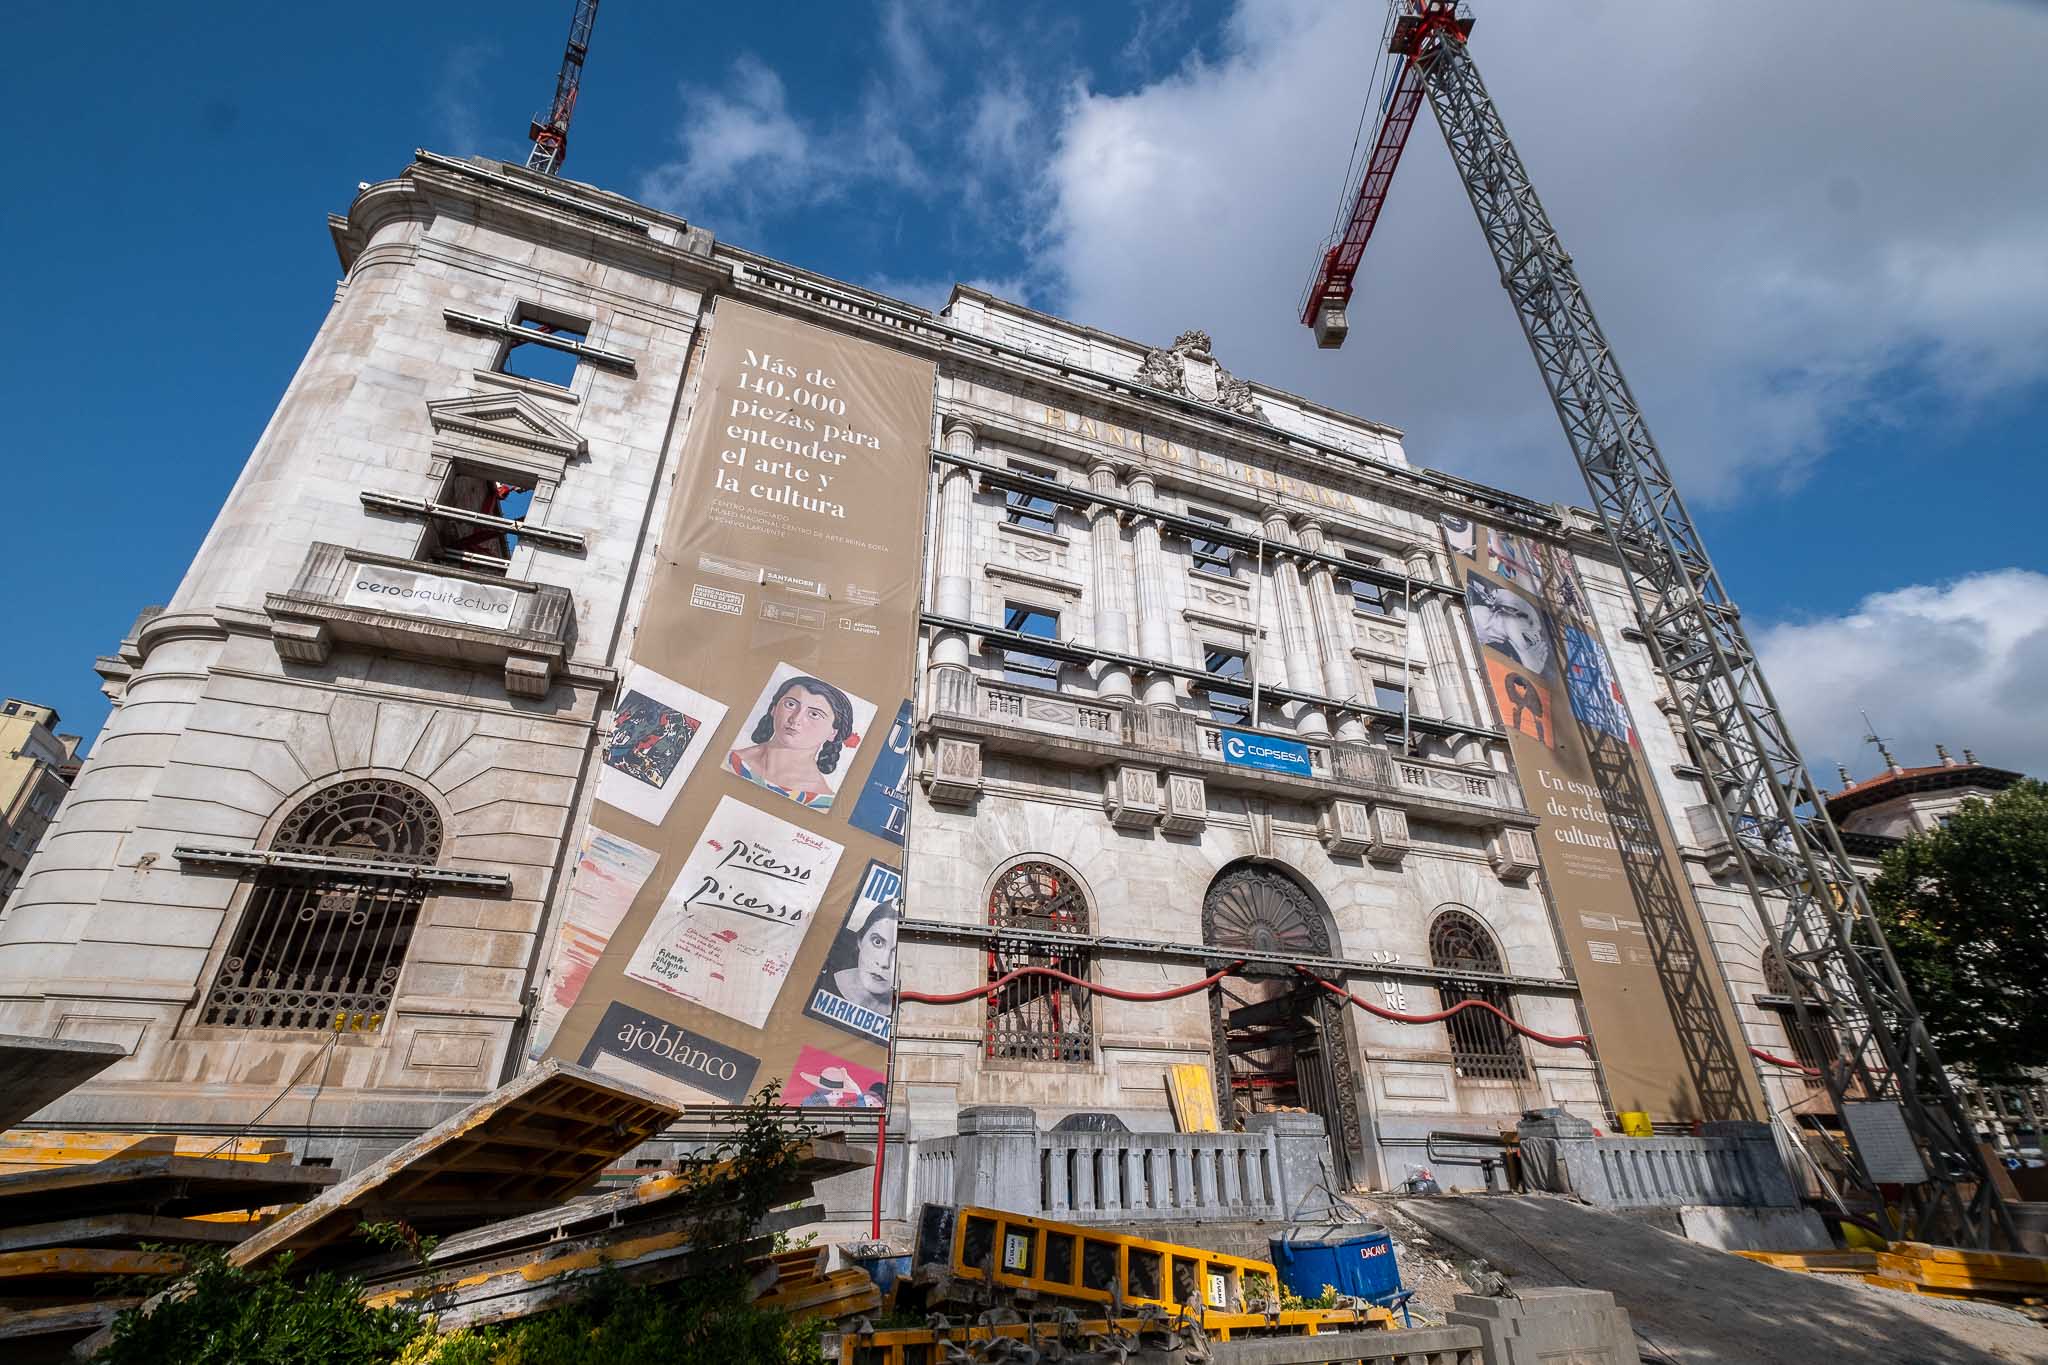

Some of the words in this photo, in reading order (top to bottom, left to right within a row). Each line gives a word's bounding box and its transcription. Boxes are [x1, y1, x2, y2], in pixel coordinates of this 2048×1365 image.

[741, 348, 797, 378] Más
[806, 369, 837, 389] de
[737, 372, 846, 416] 140.000
[731, 399, 815, 432] piezas
[823, 424, 881, 449] para
[727, 425, 847, 465] entender
[721, 447, 747, 467] el
[754, 457, 809, 482] arte
[817, 473, 834, 492] y
[715, 468, 740, 493] la
[750, 484, 846, 518] cultura
[356, 580, 509, 614] ceroarquitectura
[767, 572, 814, 587] SANTANDER
[693, 599, 717, 609] REINA
[1247, 745, 1306, 764] COPSESA
[1537, 770, 1564, 791] Un
[1547, 797, 1568, 817] de
[753, 842, 772, 854] Museo
[1555, 825, 1618, 850] cultural
[715, 840, 811, 880] Picasso
[683, 876, 803, 921] Picasso
[865, 868, 902, 904] ПР
[617, 1020, 737, 1081] ajoblanco
